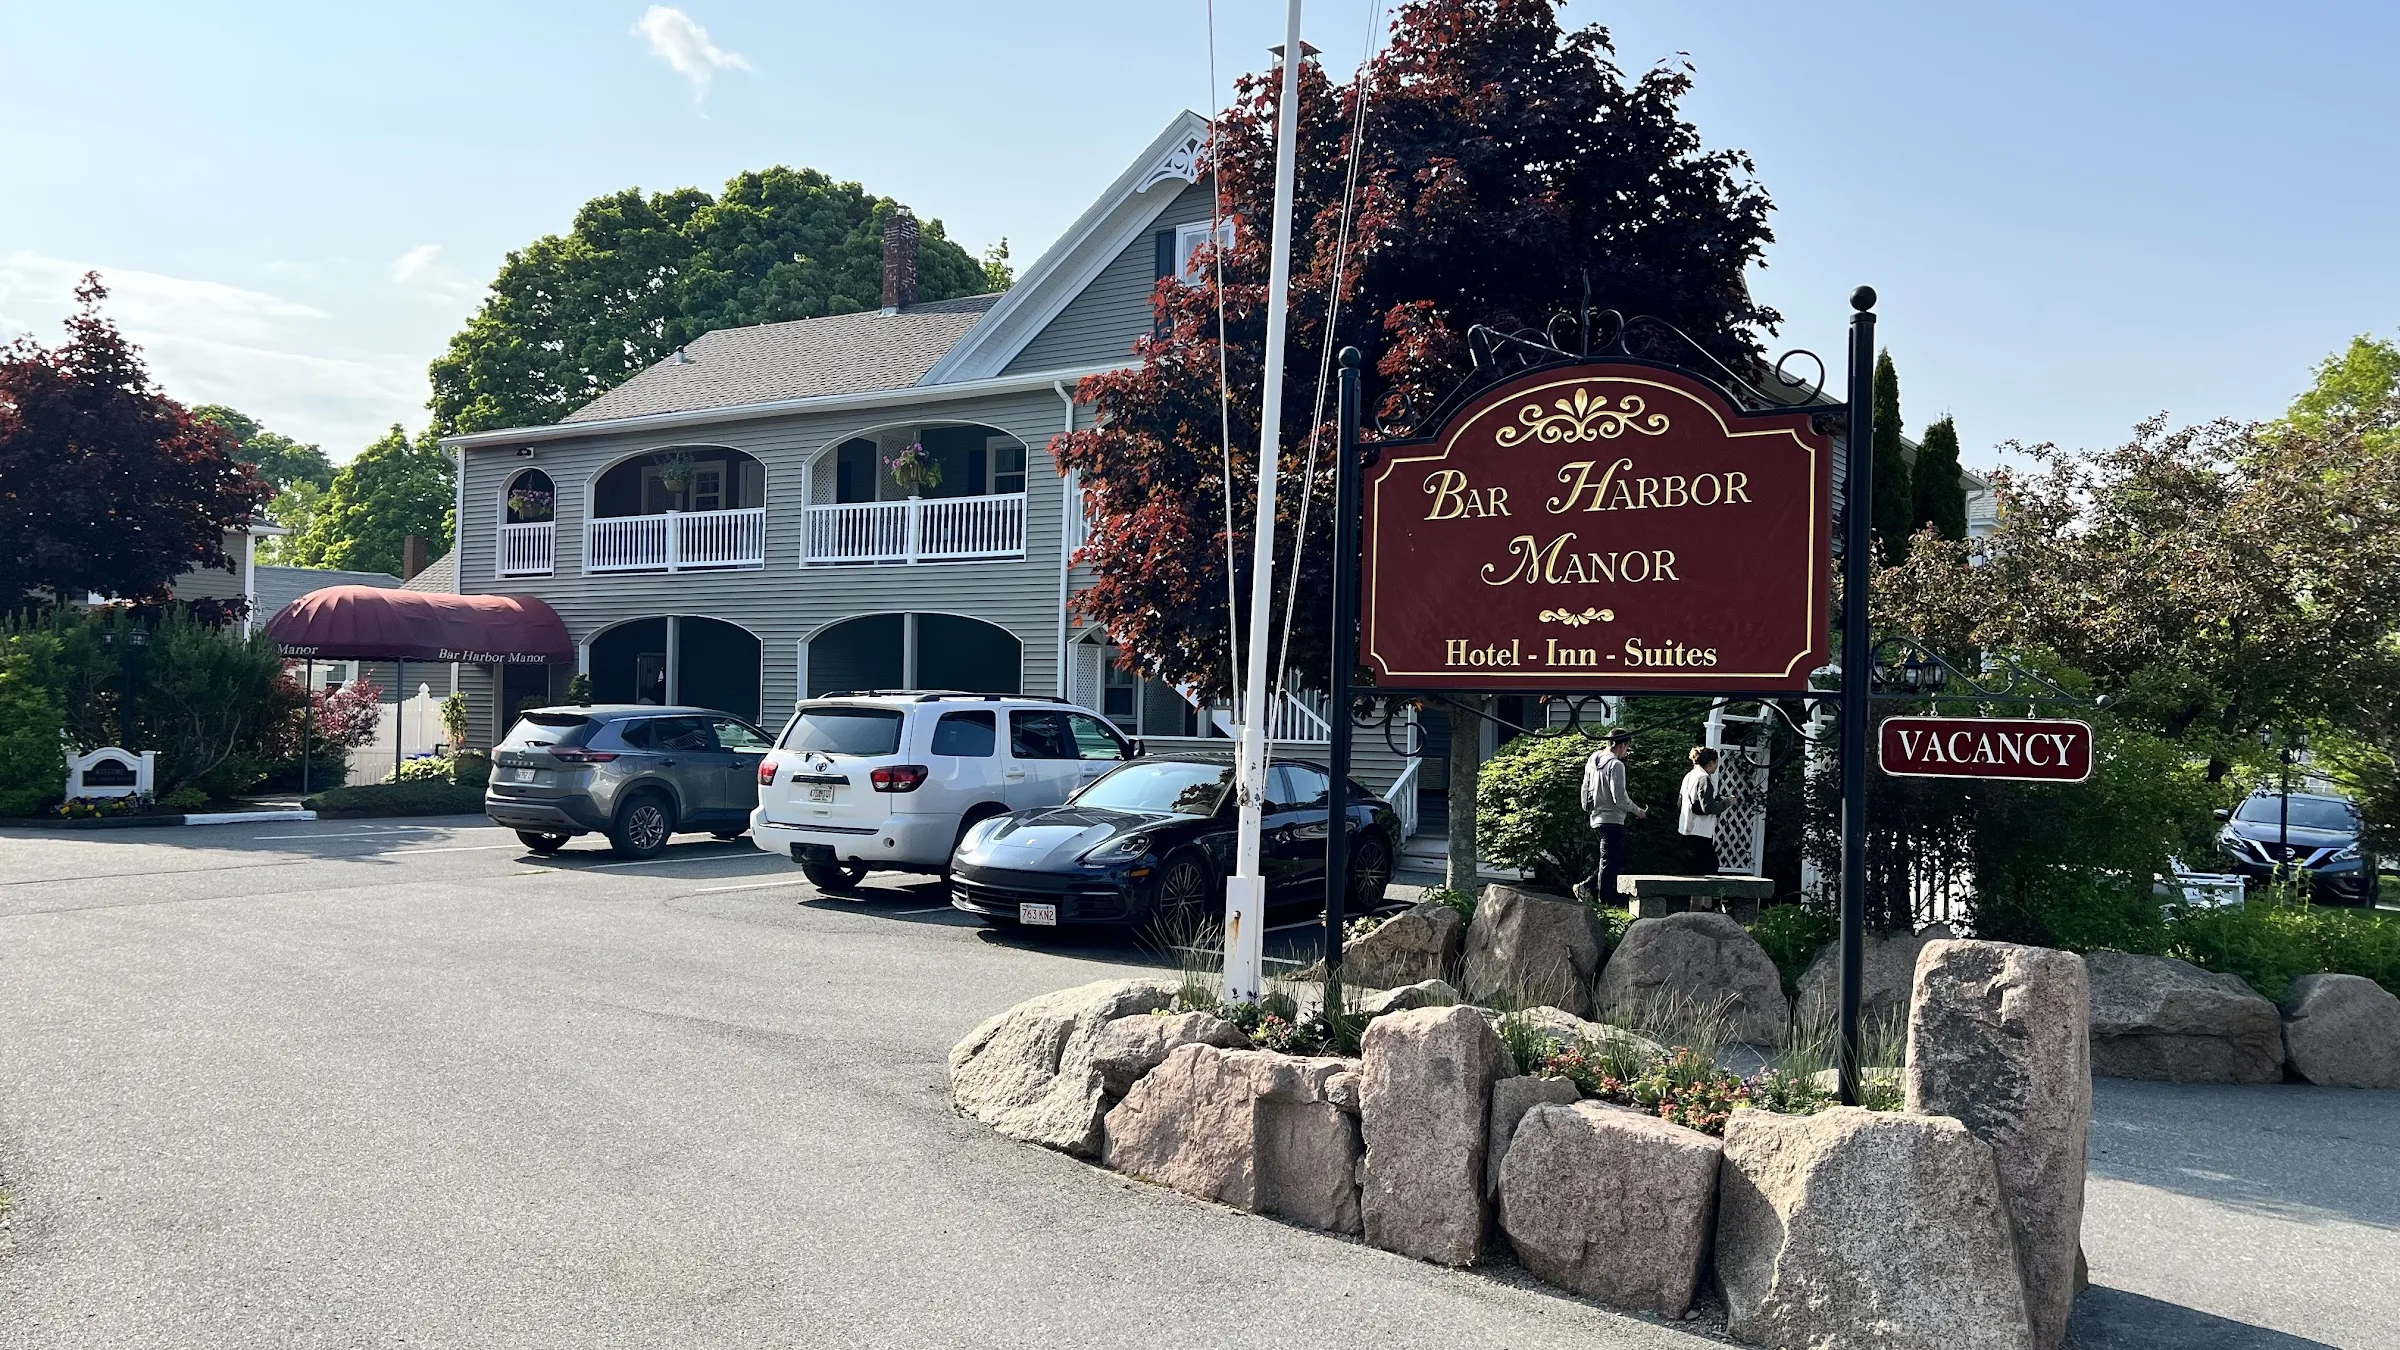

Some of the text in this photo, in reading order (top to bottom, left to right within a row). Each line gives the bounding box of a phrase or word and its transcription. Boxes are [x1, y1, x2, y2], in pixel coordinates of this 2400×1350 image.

[1422, 457, 1753, 521] BAR HARBOR
[1480, 532, 1680, 586] MANOR
[277, 643, 319, 655] Manor
[438, 648, 546, 663] Bar Harbor Manor
[1444, 638, 1521, 667] Hotel
[1544, 638, 1599, 667] Inn
[1624, 637, 1718, 667] Suites
[1896, 730, 2077, 767] VACANCY
